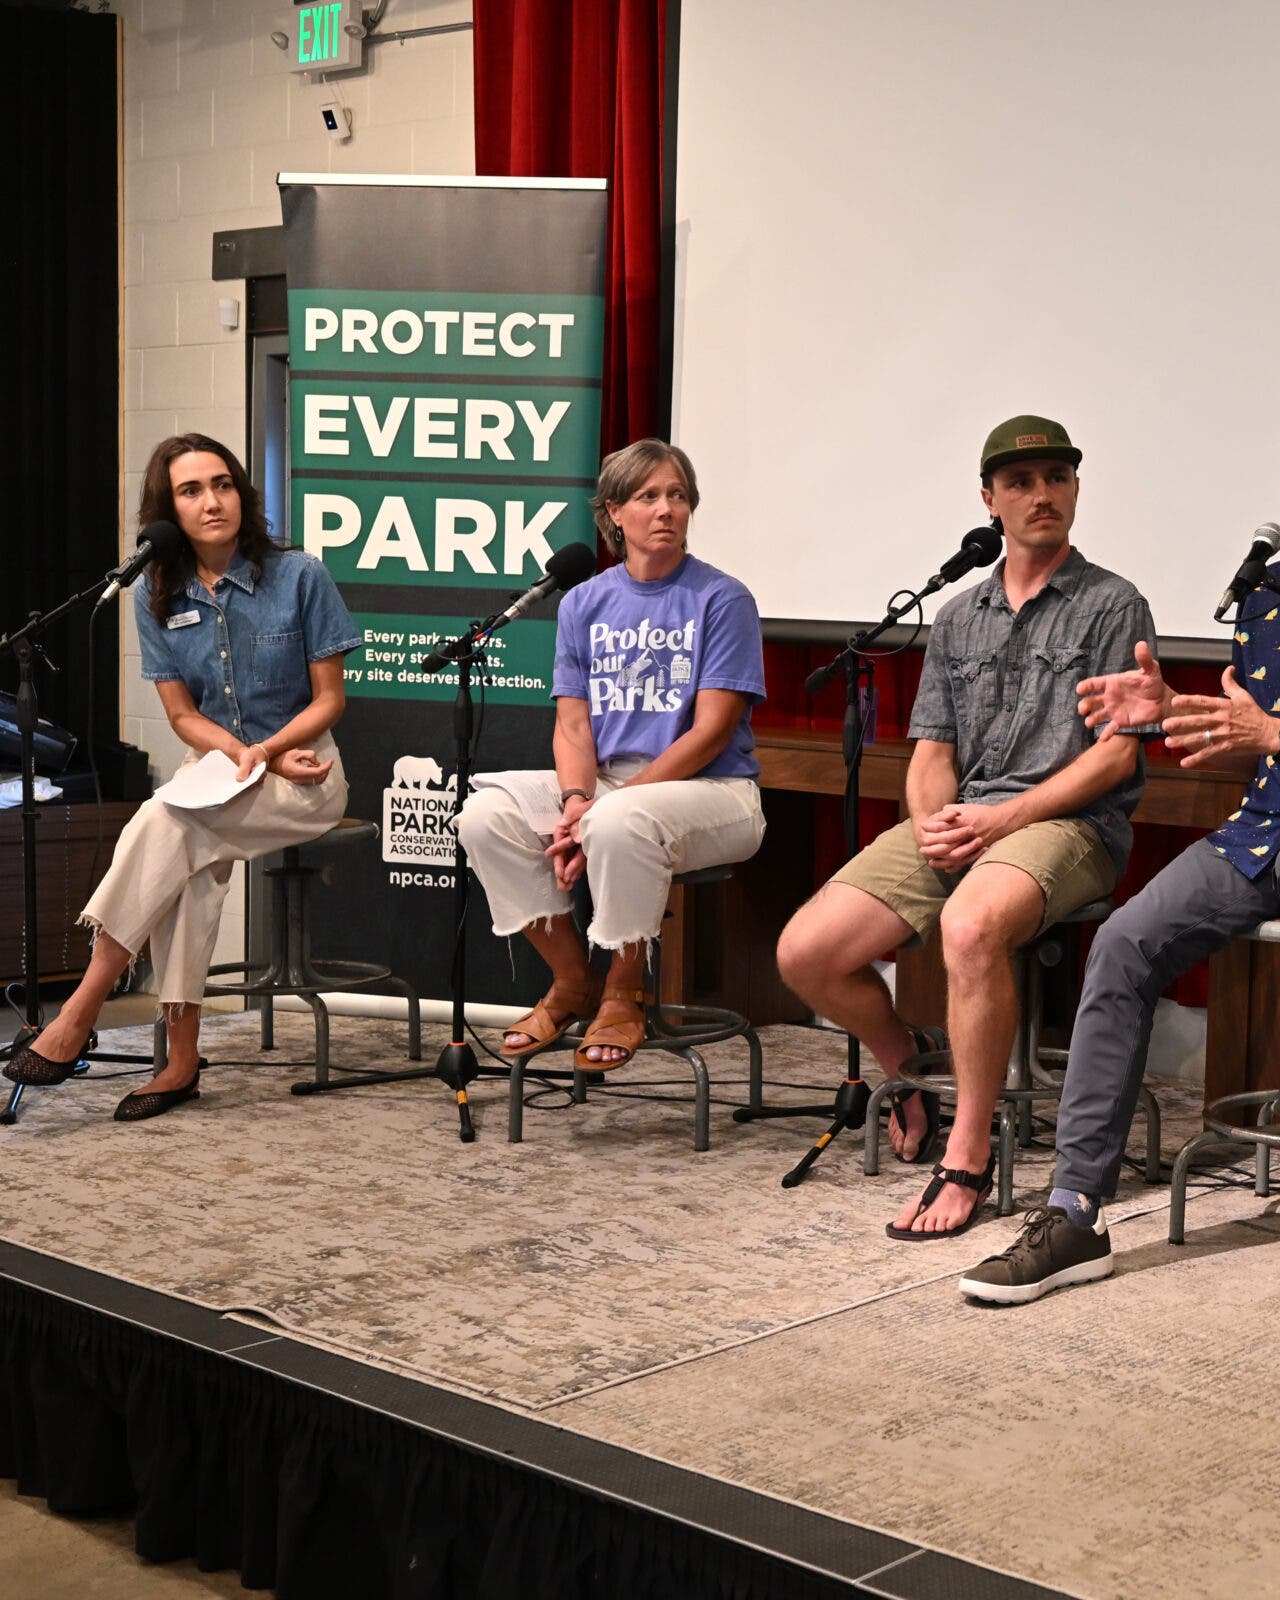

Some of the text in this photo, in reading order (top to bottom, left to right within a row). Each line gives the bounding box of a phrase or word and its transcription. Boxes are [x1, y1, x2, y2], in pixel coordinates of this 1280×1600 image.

[299, 3, 342, 63] EXIT
[305, 307, 575, 358] PROTECT
[304, 394, 572, 462] EVERY
[304, 493, 569, 576] PARK
[364, 629, 405, 646] Every
[409, 632, 440, 647] park
[590, 618, 696, 657] Protect
[365, 649, 406, 665] Every
[591, 653, 626, 674] our
[343, 669, 363, 683] ery
[367, 668, 393, 682] site
[397, 669, 460, 685] deserves
[589, 676, 682, 716] Parks
[391, 797, 458, 813] NATIONA
[391, 812, 456, 836] PARK
[390, 834, 456, 847] CONSERVATI
[389, 871, 456, 888] npca.or
